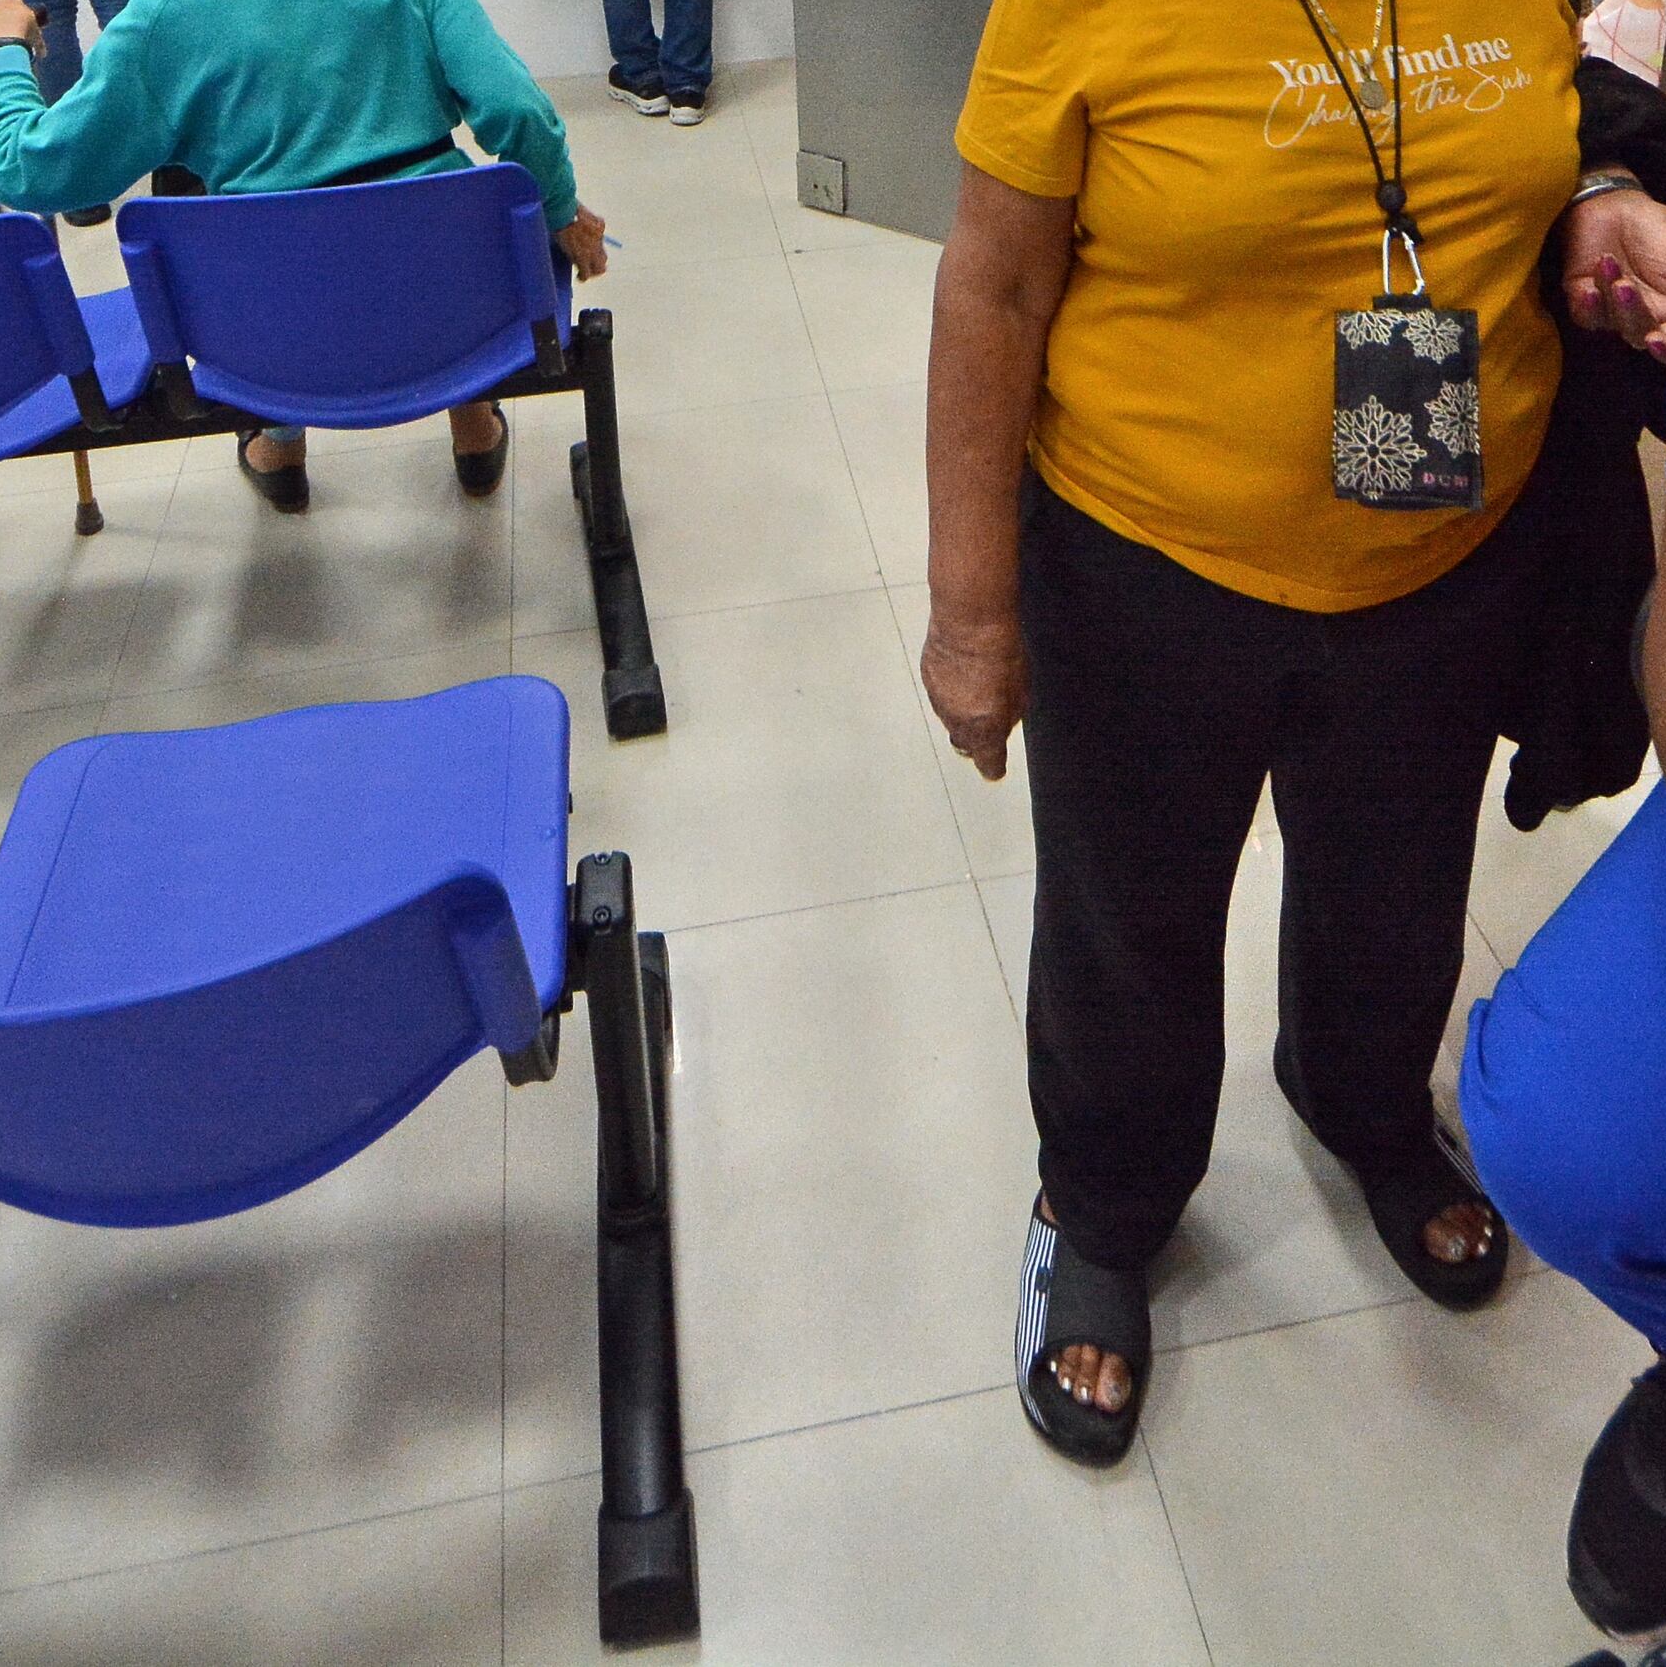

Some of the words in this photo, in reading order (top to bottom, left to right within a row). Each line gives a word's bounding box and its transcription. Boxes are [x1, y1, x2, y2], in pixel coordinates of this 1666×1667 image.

[1269, 47, 1379, 88] You'll
[1383, 34, 1462, 79] find
[1464, 37, 1512, 65] me
[1410, 75, 1461, 114] the
[1464, 65, 1532, 112] Sun
